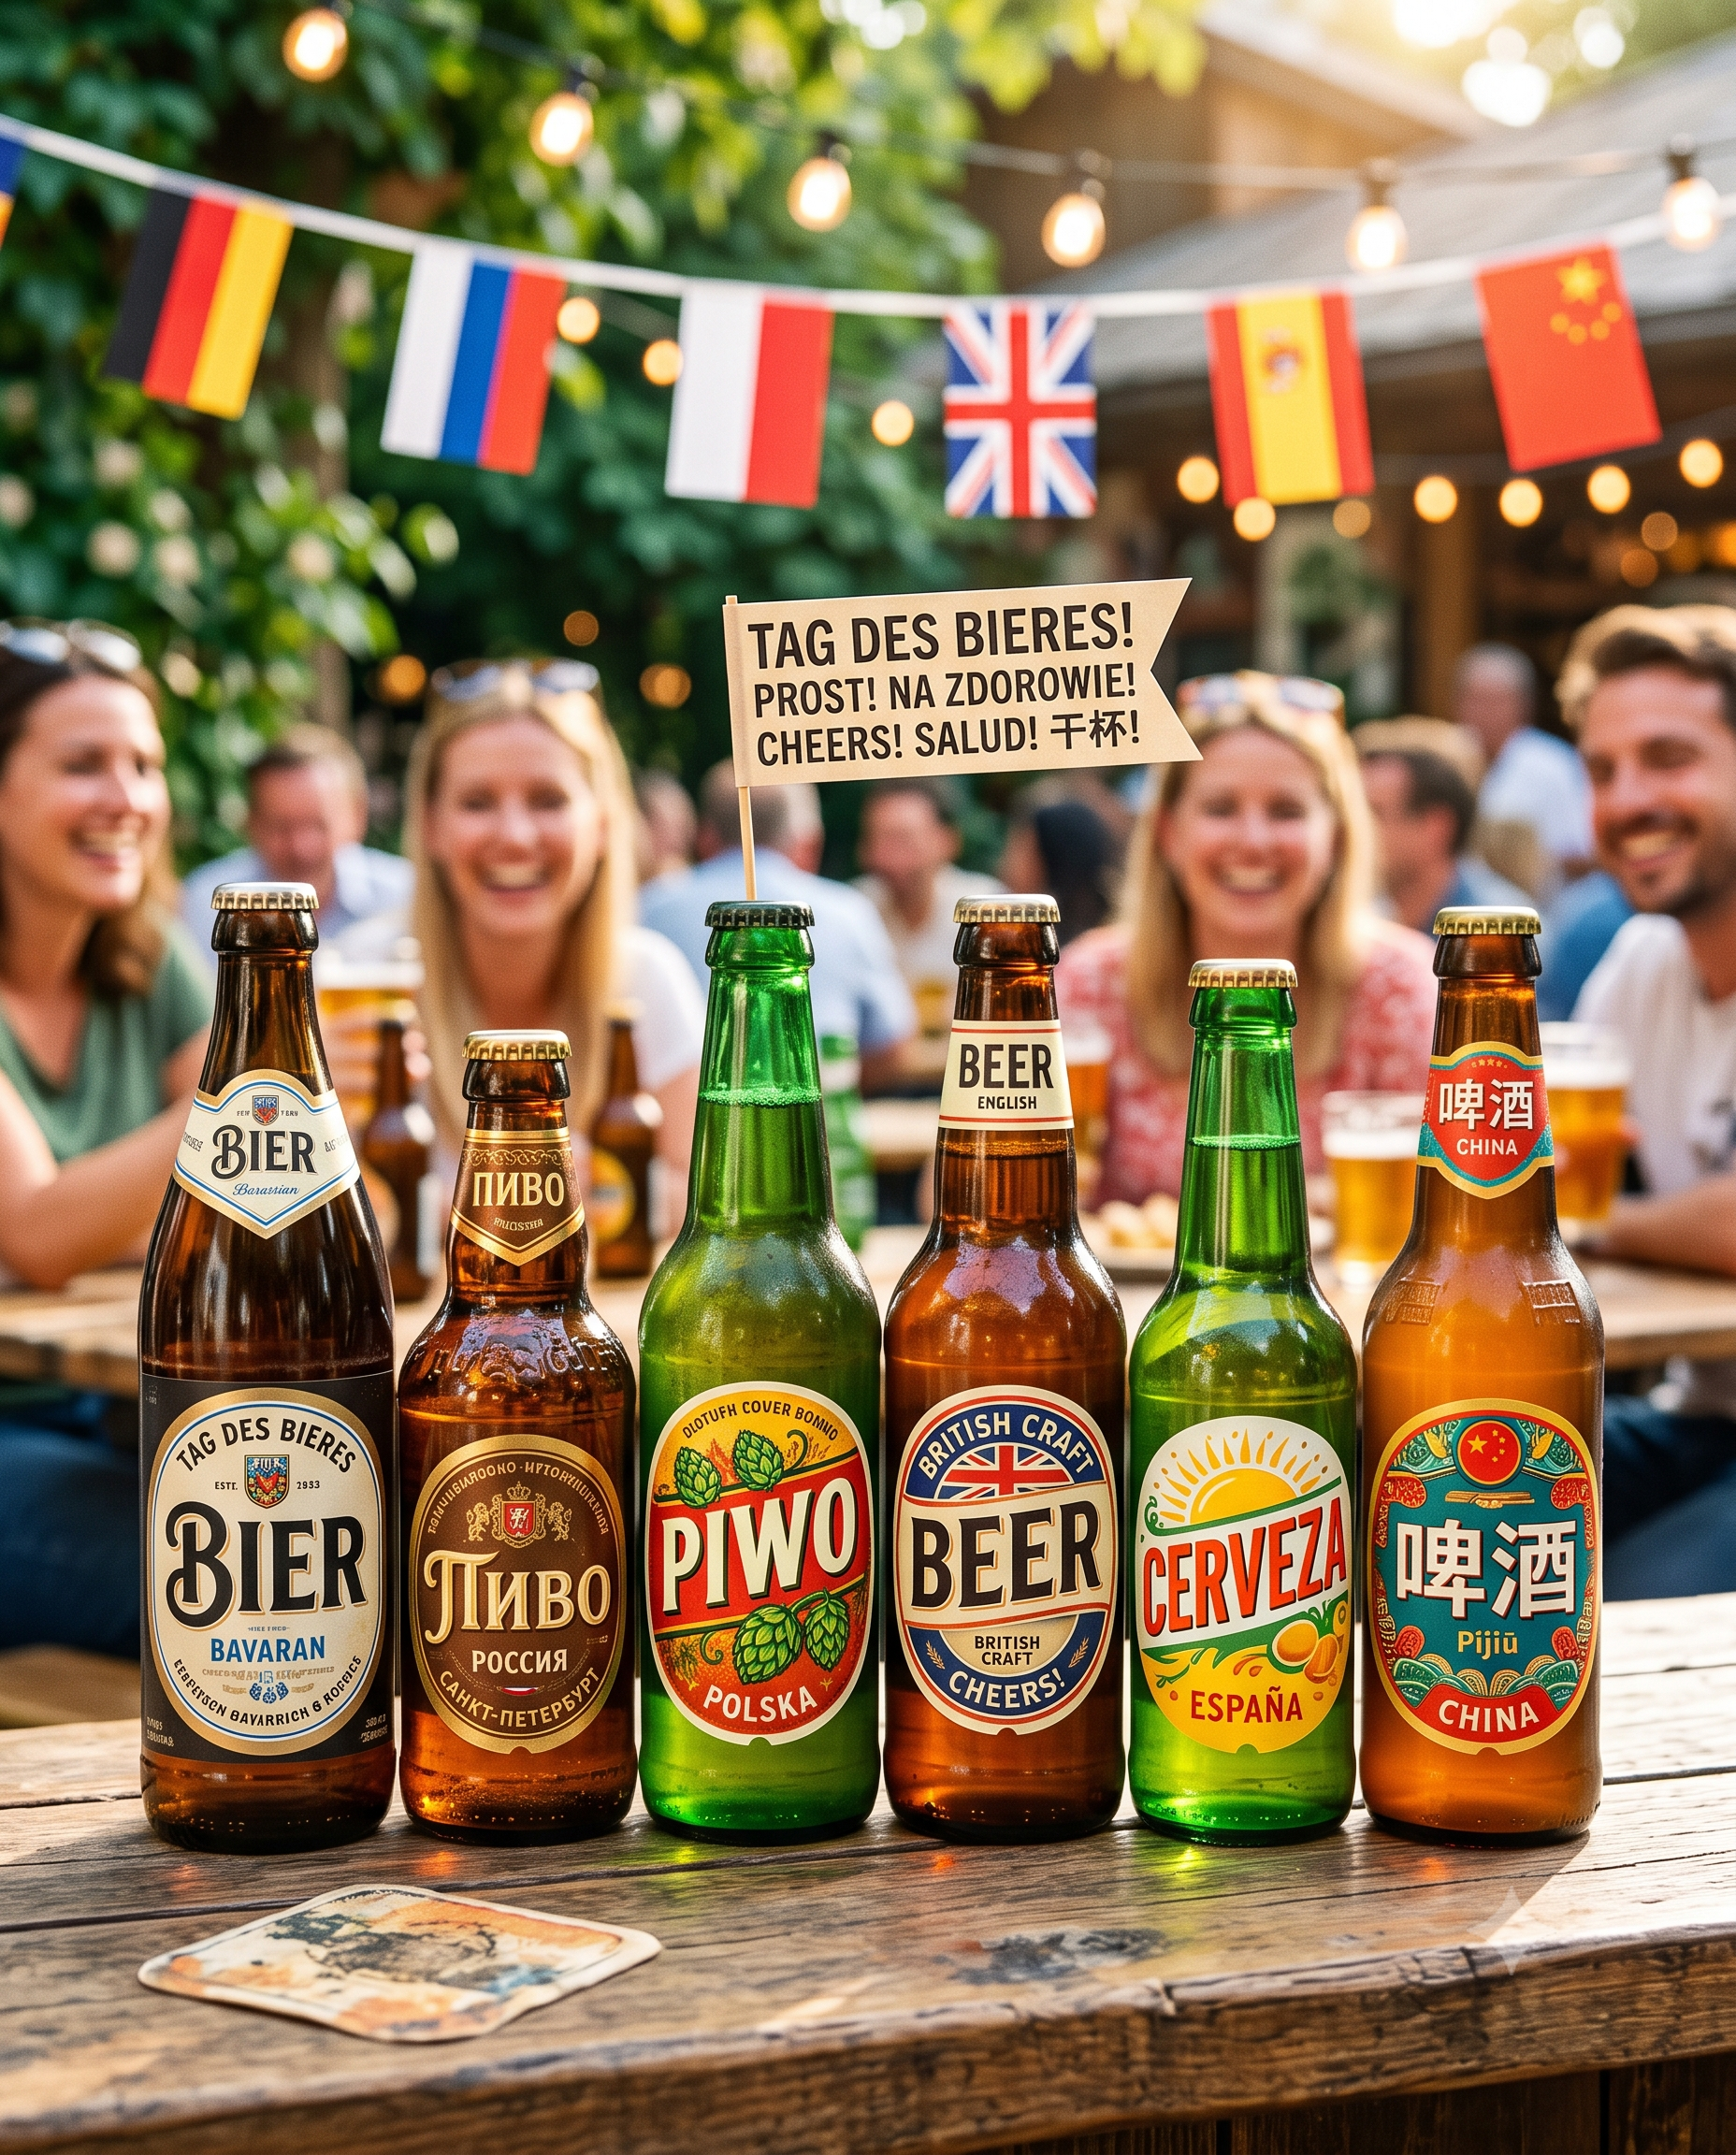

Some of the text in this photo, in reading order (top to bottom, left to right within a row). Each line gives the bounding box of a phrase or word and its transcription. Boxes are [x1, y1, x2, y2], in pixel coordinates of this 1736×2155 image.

[748, 601, 1135, 670] TAG DES BIERES!
[754, 662, 1136, 718] PROST! NA ZDOROWIE!
[757, 709, 1140, 767] CHEERS! SALUD! 干杯!
[959, 1044, 1054, 1089] BEER
[977, 1095, 1037, 1109] ENGLISH
[1439, 1078, 1534, 1131] 啤酒
[211, 1124, 318, 1179] BIER
[1456, 1138, 1518, 1155] CHINA
[472, 1172, 565, 1207] ПИВО
[742, 1400, 790, 1417] COVER
[176, 1417, 356, 1473] TAG DES BIERES
[918, 1411, 1094, 1481] BRITISH CRAFT
[165, 1500, 369, 1631] BIER
[662, 1477, 858, 1616] PIWO
[911, 1500, 1103, 1612] BEER
[1143, 1497, 1347, 1637] CERVEZA
[1396, 1518, 1578, 1620] 啤酒
[210, 1635, 326, 1664] BAVARAN
[472, 1648, 568, 1674] РОССИЯ
[975, 1635, 1040, 1650] BRITISH
[981, 1652, 1033, 1666] CRAFT
[703, 1684, 817, 1723] POLSKA
[949, 1668, 1065, 1709] CHEERS!
[1191, 1685, 1303, 1724] ESPAÑA
[1439, 1699, 1540, 1733] CHINA
